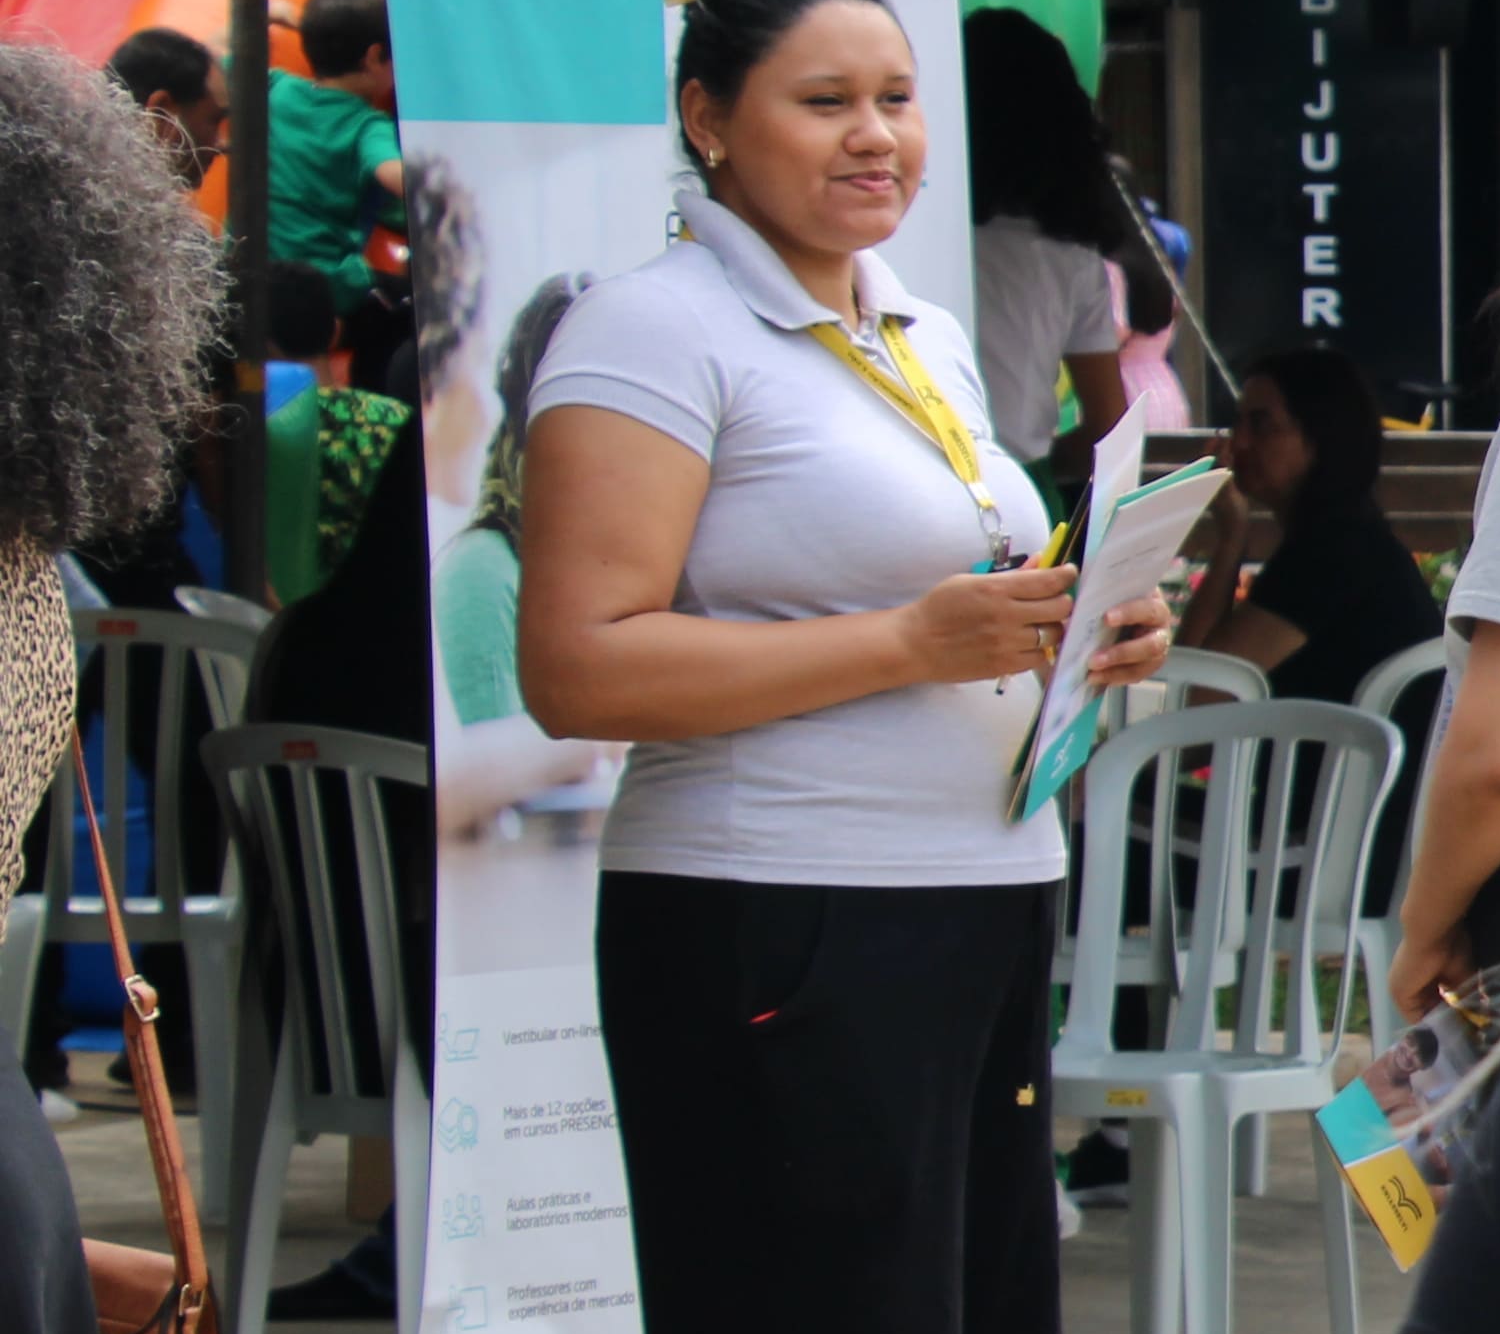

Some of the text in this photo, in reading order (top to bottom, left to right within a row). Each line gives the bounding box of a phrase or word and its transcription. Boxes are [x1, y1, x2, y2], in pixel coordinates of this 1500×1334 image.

[503, 1024, 601, 1045] Vestibular on-line
[503, 1097, 606, 1120] Mais de 12 opções
[504, 1114, 617, 1139] em cursos PRESENC
[506, 1192, 591, 1212] Aulas práticas e
[506, 1205, 627, 1231] laboratórios modernos
[507, 1278, 597, 1301] Professores com
[508, 1291, 635, 1322] experiência de mercado
